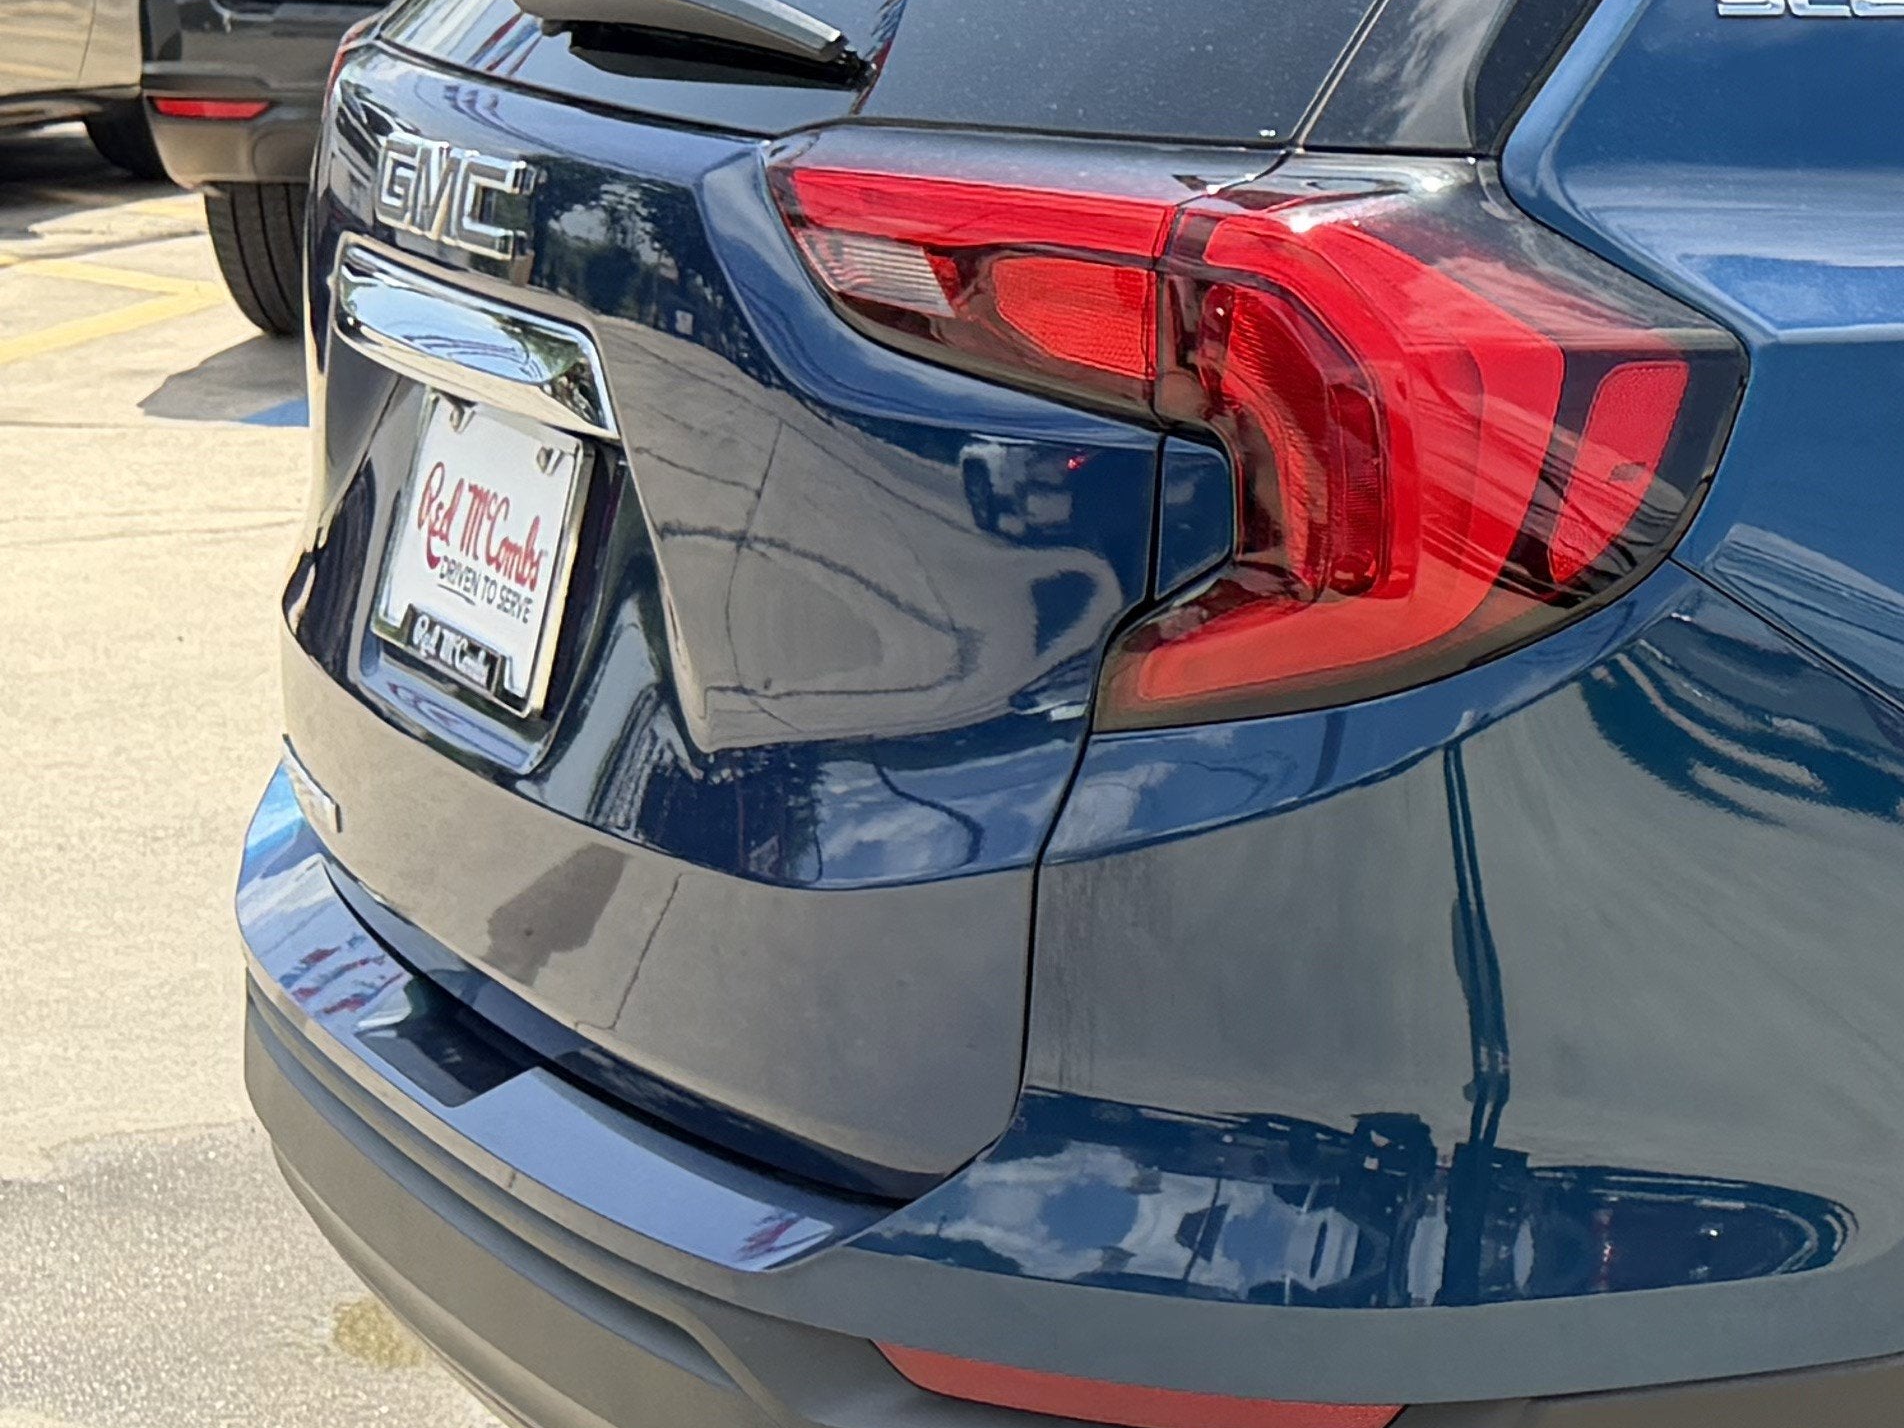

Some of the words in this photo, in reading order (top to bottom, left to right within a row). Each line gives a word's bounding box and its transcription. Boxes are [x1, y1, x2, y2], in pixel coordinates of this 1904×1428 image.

[375, 130, 531, 262] GMC
[417, 461, 465, 570] Red
[439, 555, 481, 597] DRIVEN
[480, 572, 498, 605] TO
[496, 584, 534, 624] SERVE
